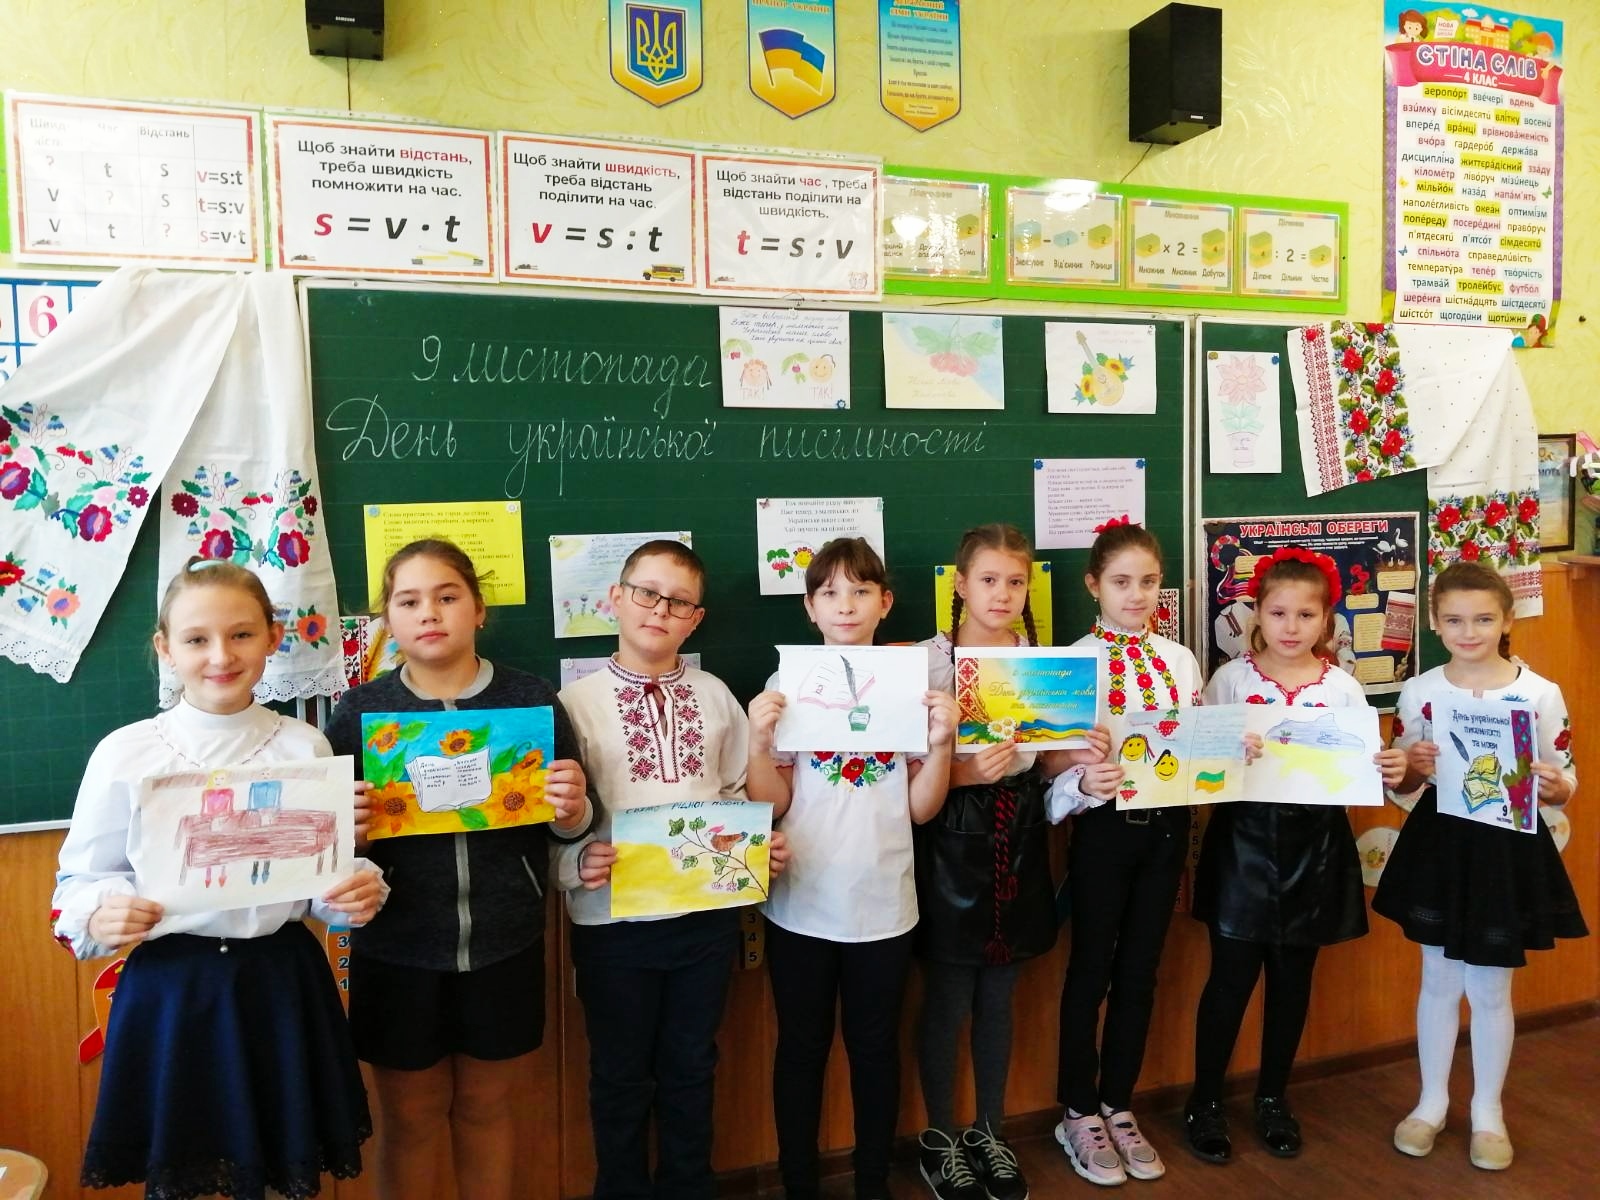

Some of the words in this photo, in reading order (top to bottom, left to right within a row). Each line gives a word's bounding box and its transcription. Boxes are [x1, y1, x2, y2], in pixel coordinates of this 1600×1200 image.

[1416, 44, 1487, 72] СТІНА
[1490, 53, 1538, 81] СЛІВ
[1463, 71, 1470, 83] 4
[1472, 73, 1498, 87] КЛАС
[1509, 98, 1534, 108] вдень
[139, 126, 190, 139] Відстань
[298, 140, 335, 155] Щоб
[340, 144, 395, 158] знайти
[400, 147, 472, 165] відстань,
[319, 160, 366, 174] треба
[372, 164, 453, 180] швидкість
[514, 153, 547, 166] Щоб
[552, 158, 601, 171] знайти
[605, 162, 681, 180] швидкість,
[312, 178, 403, 193] помножити
[409, 185, 427, 195] на
[432, 186, 462, 197] час.
[545, 174, 586, 187] треба
[591, 177, 652, 192] відстань
[716, 169, 747, 182] Щоб
[751, 173, 796, 186] знайти
[832, 178, 868, 190] треба
[539, 190, 604, 205] поділити
[609, 196, 625, 206] на
[630, 199, 657, 209] час.
[723, 187, 781, 201] відстань
[785, 192, 843, 205] поділити
[846, 195, 861, 205] на
[759, 205, 829, 219] швидкість.
[1177, 242, 1186, 257] 2
[1286, 248, 1295, 263] 2
[29, 294, 58, 338] 6
[411, 335, 441, 381] 9
[452, 343, 713, 420] листопада
[325, 393, 458, 462] День
[504, 416, 718, 500] української
[1239, 521, 1322, 538] УКРАЇНСЬКІ
[1326, 519, 1389, 535] ОБЕРЕГИ
[1502, 804, 1508, 817] 9
[338, 935, 350, 949] 3
[338, 956, 350, 971] 2
[749, 951, 758, 962] 5
[339, 977, 349, 991] 1
